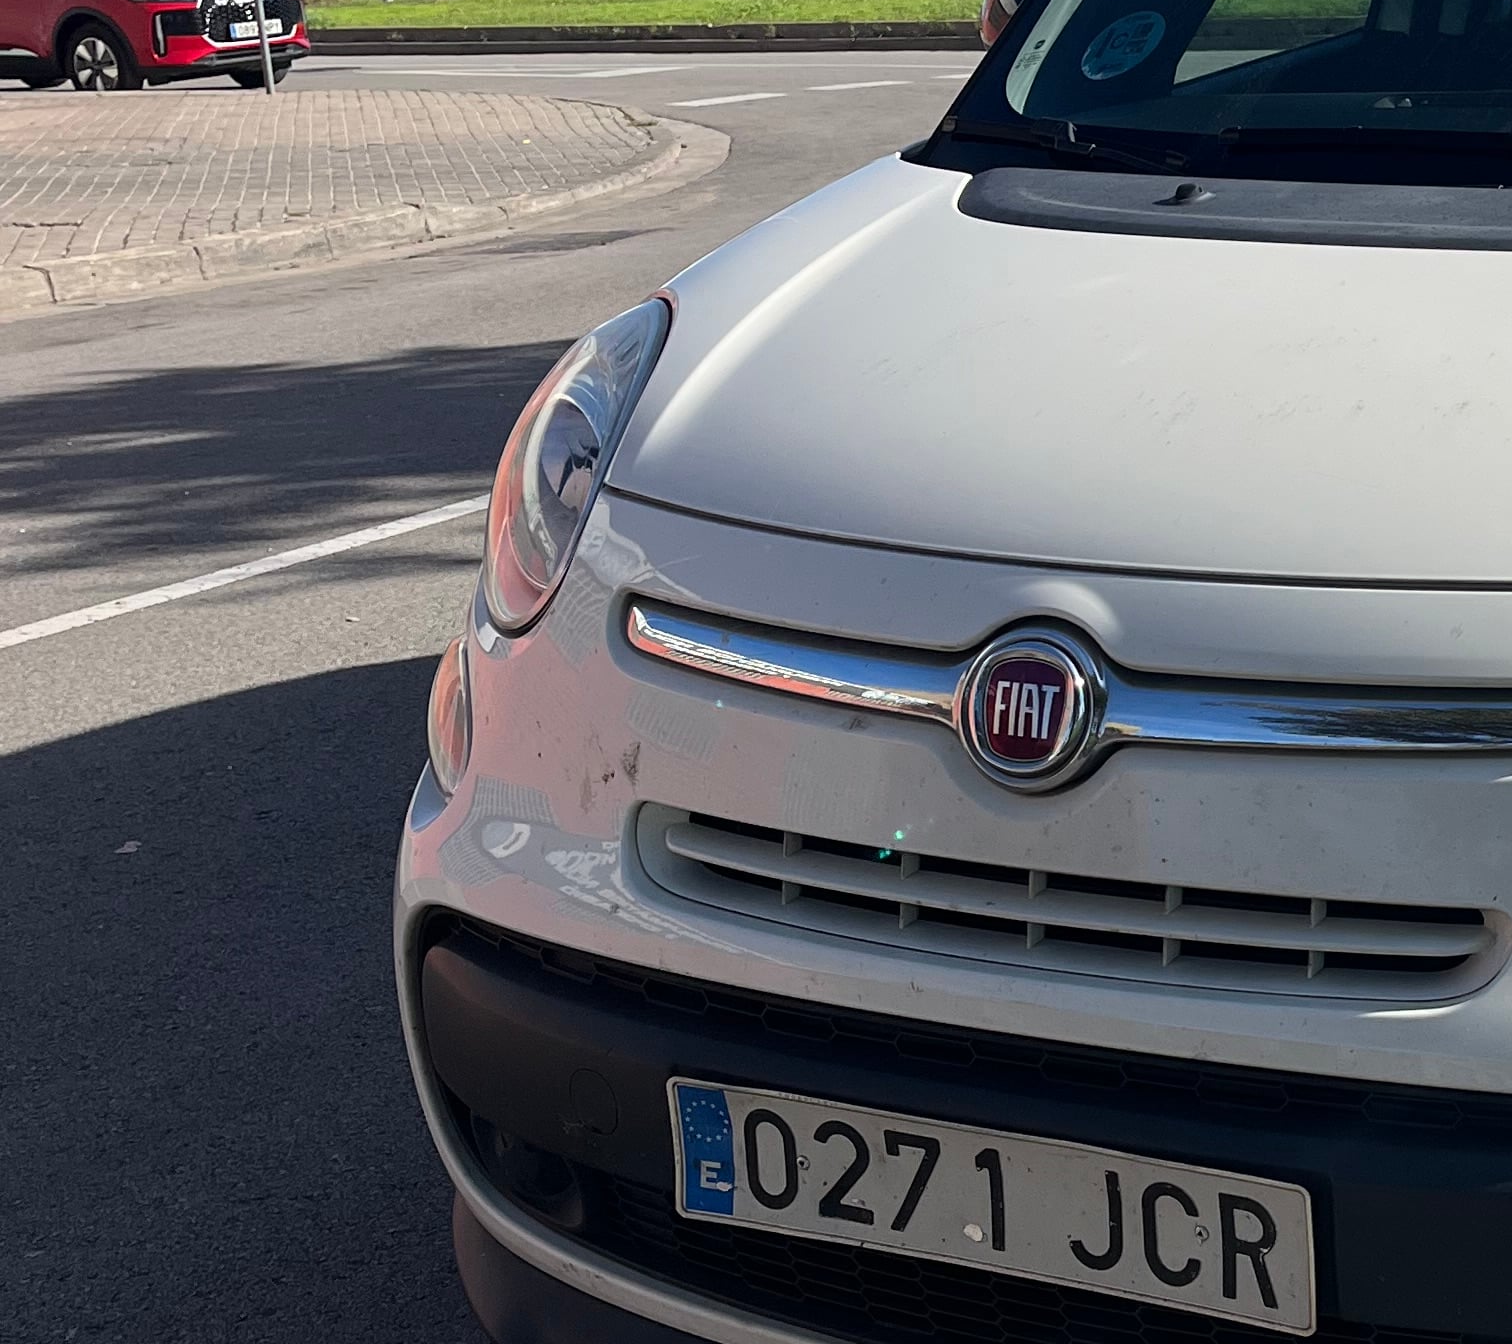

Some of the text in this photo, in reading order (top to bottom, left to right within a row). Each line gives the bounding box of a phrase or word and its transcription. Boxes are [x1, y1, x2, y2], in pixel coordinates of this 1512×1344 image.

[993, 680, 1060, 740] FIAT
[700, 1160, 731, 1190] E
[743, 1108, 1279, 1309] 0271 JCR
